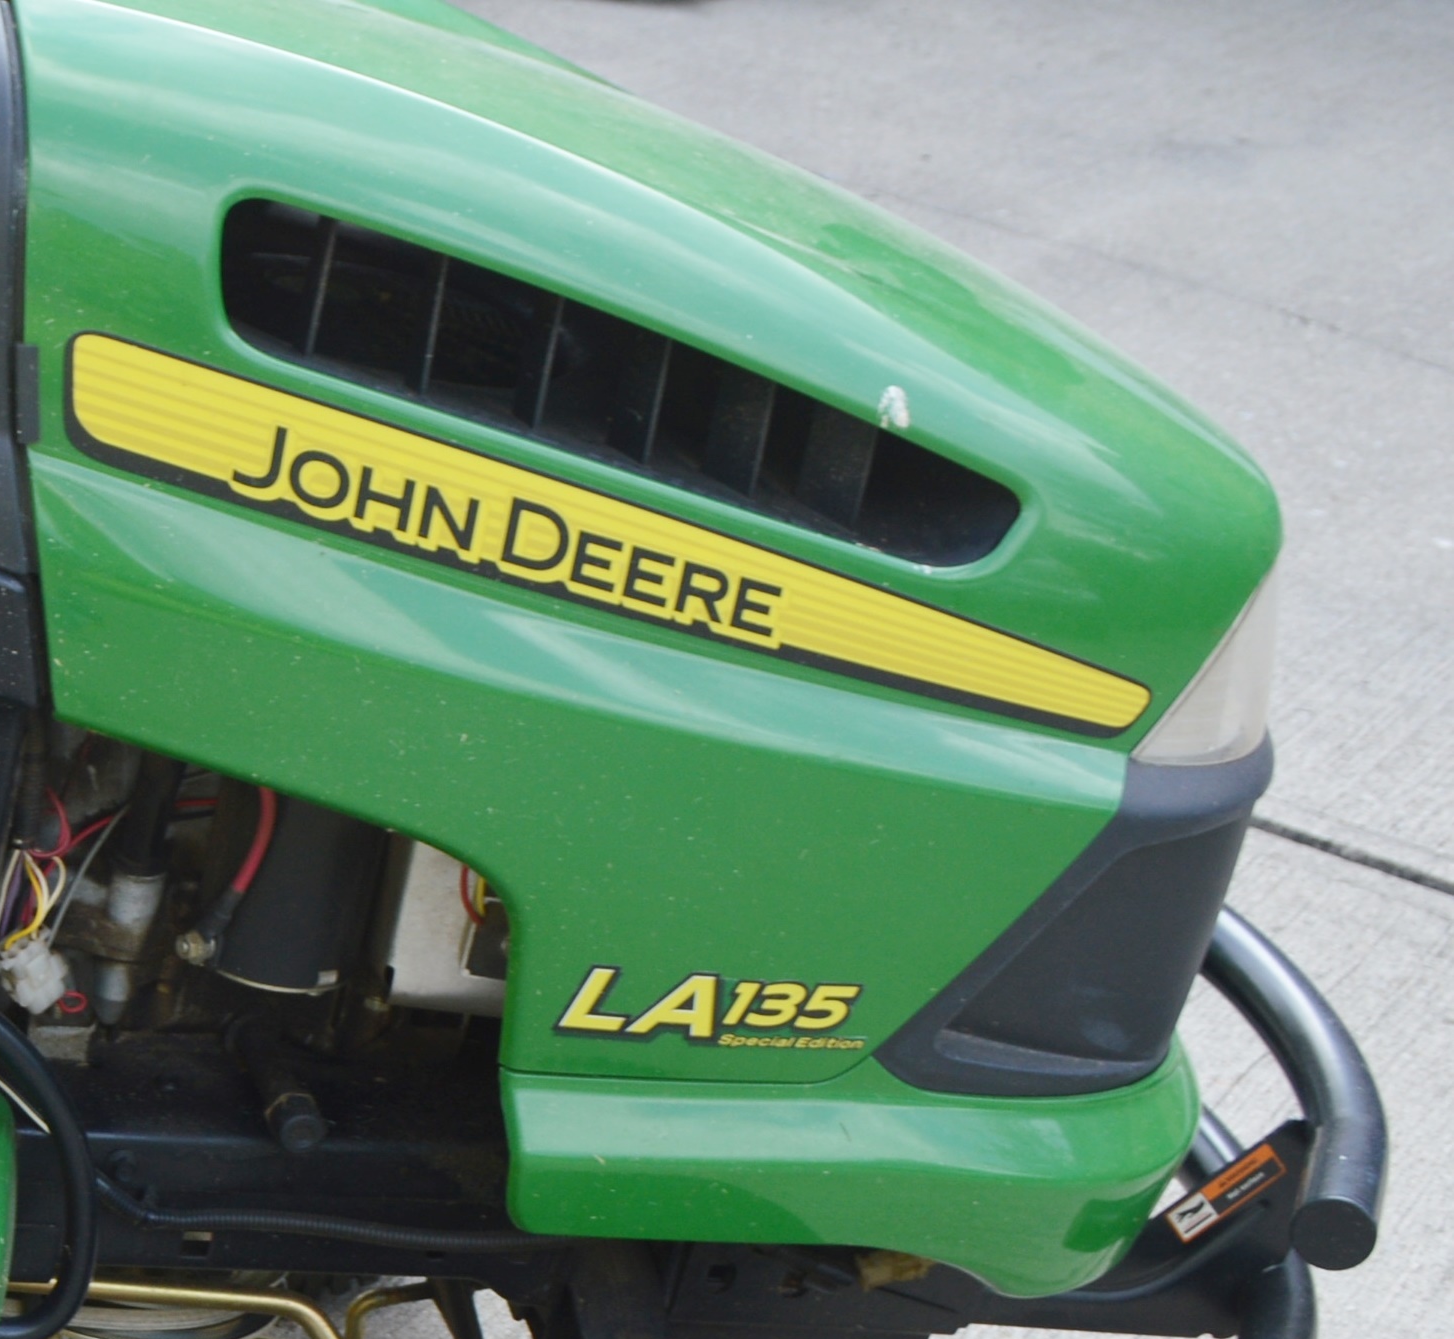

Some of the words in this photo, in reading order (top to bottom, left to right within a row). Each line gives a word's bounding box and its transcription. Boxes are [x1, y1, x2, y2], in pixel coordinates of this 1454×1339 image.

[230, 425, 480, 555] JOHN
[504, 497, 785, 638] DEERE
[717, 1033, 792, 1049] Special
[793, 1035, 866, 1051] Edition
